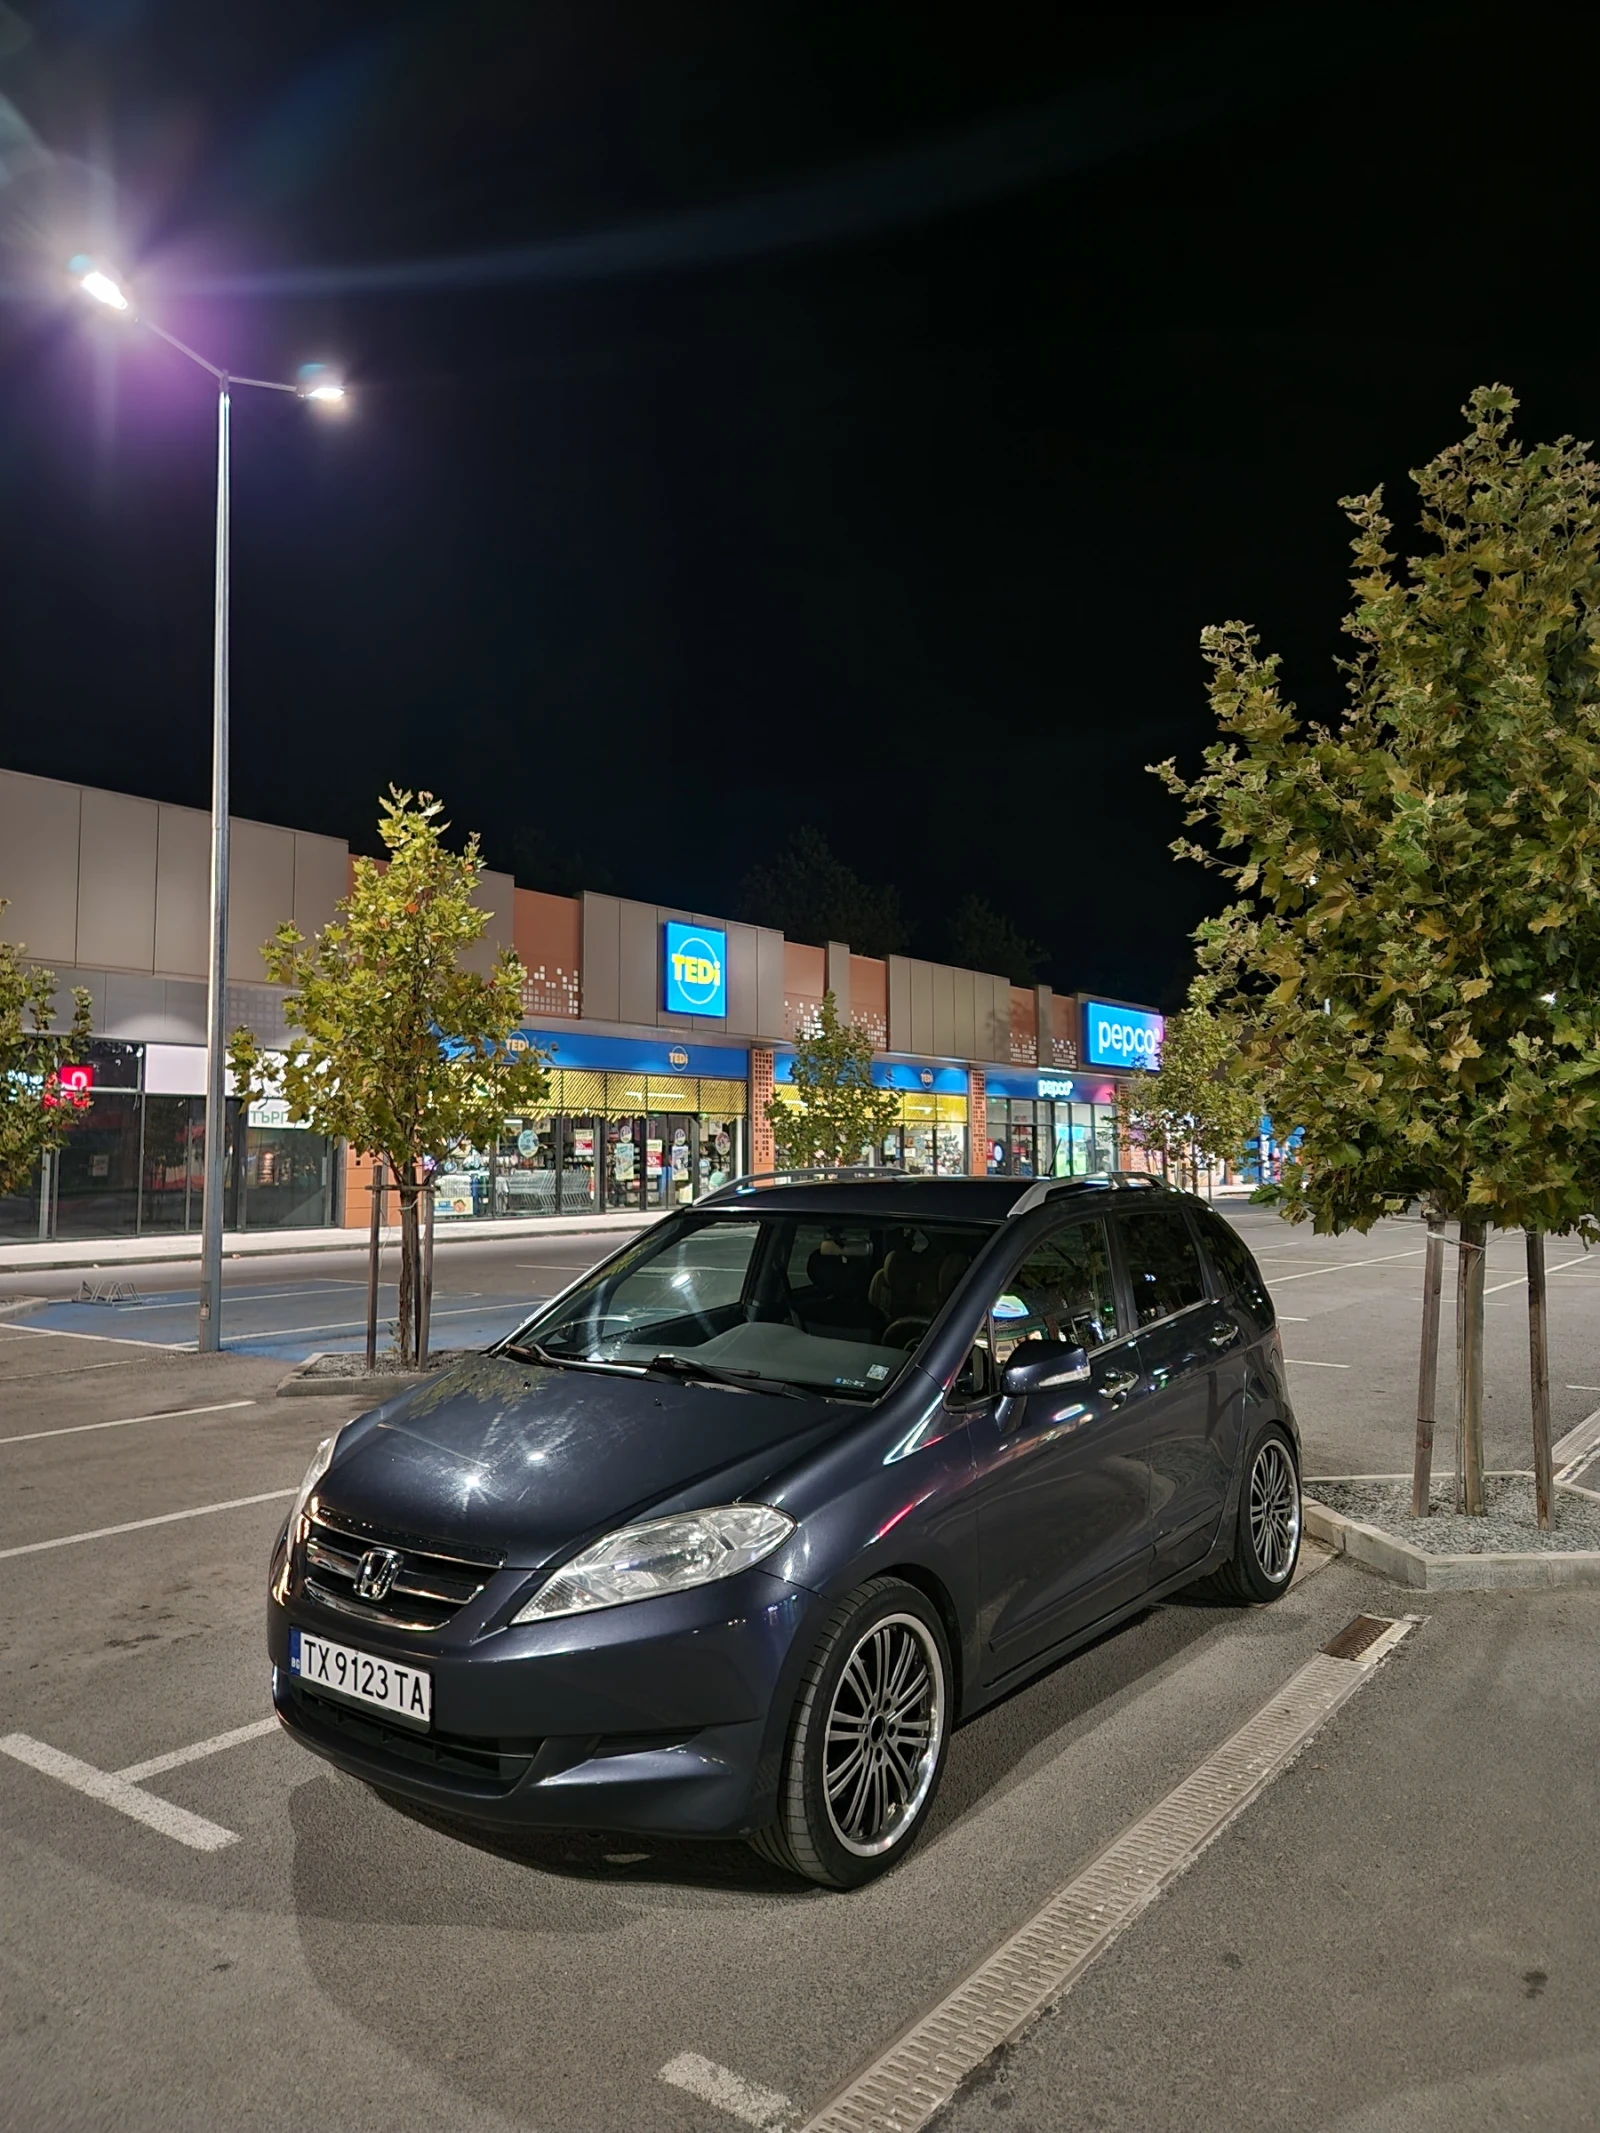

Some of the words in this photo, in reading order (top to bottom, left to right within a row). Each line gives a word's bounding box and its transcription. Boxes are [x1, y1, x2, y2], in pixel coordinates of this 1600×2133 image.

[671, 953, 721, 987] TEDi
[1098, 1021, 1156, 1057] pepco
[669, 1052, 688, 1065] TEDi
[1037, 1079, 1072, 1098] pepco
[250, 1110, 290, 1125] ТЪРГ
[291, 1657, 300, 1669] BG
[304, 1639, 330, 1681] TX
[335, 1651, 388, 1700] 9123
[394, 1669, 425, 1714] TA
